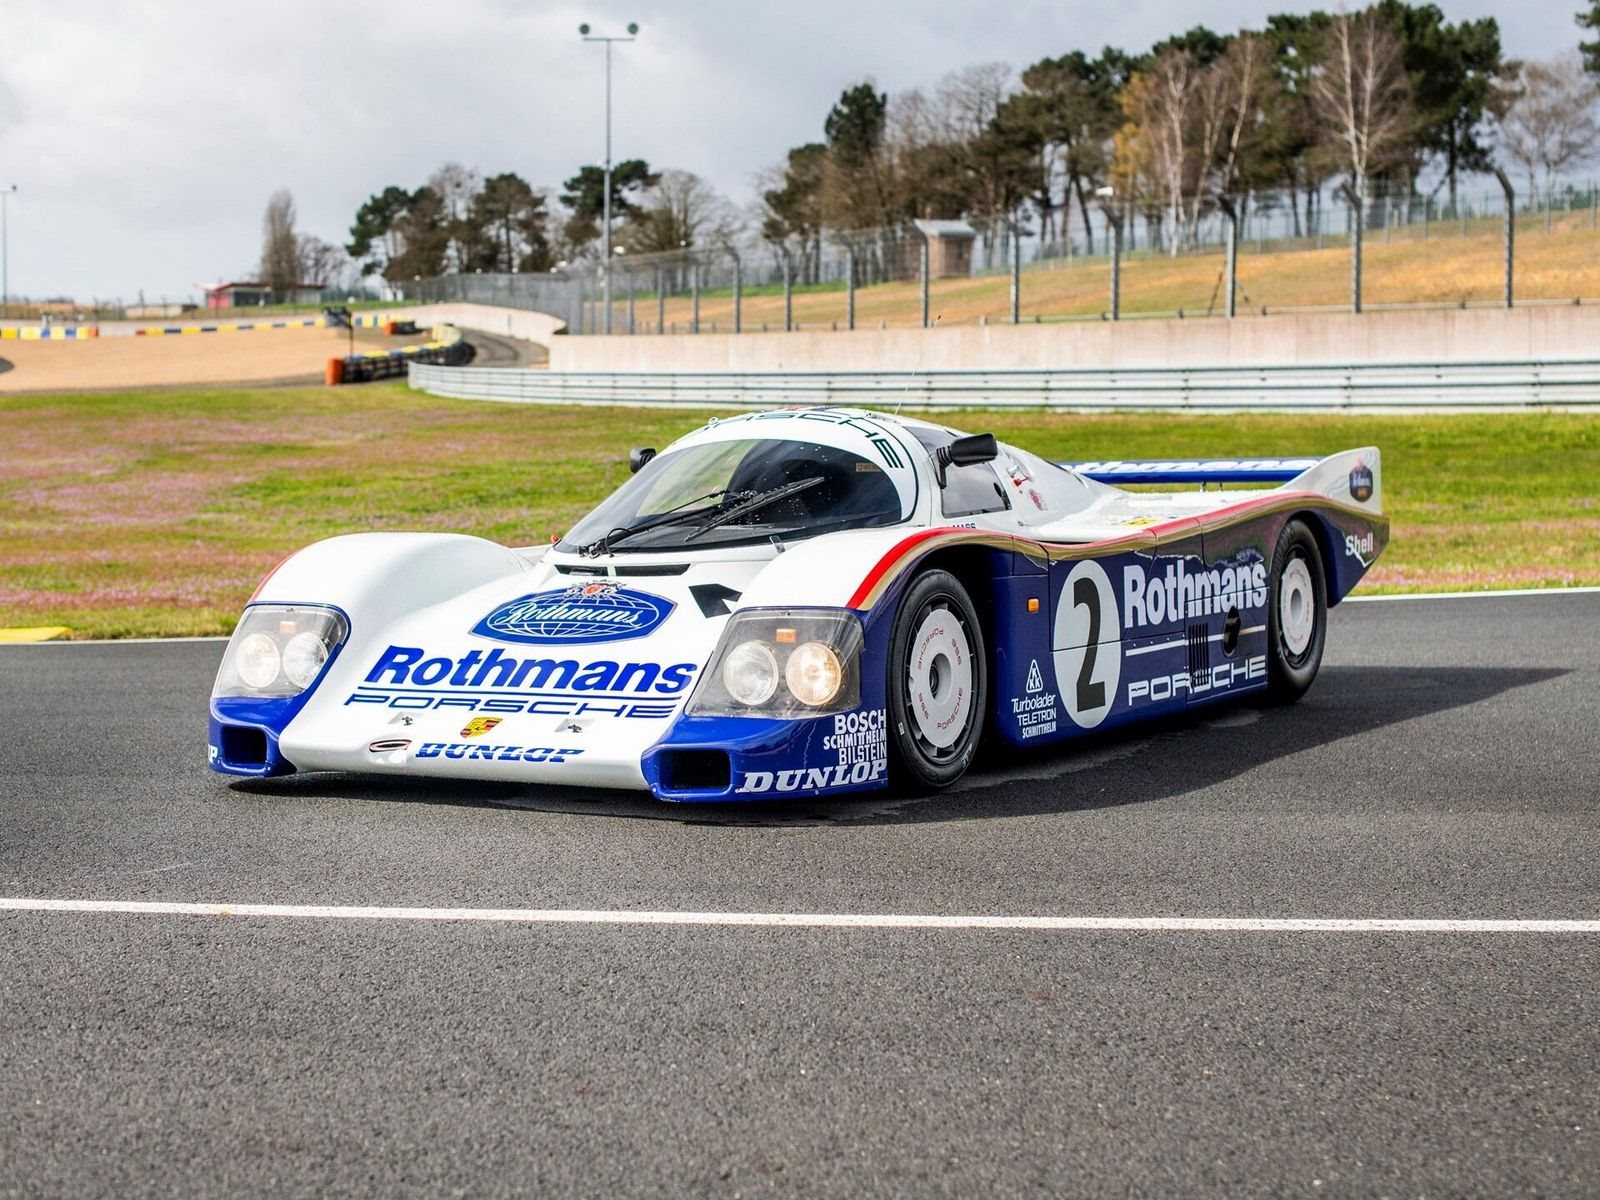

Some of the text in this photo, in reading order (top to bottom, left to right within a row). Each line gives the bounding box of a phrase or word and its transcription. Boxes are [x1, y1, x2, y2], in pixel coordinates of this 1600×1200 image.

[730, 411, 904, 469] SCHE
[1345, 532, 1373, 556] Shell
[1124, 560, 1267, 629] Rothmans
[495, 601, 644, 626] Rothmans
[1073, 577, 1106, 713] 2
[363, 645, 698, 693] Rothmans
[1128, 655, 1266, 706] PORSCHE
[344, 694, 677, 719] PORSCHE
[1011, 692, 1056, 713] Turbolader
[834, 709, 887, 735] BOSCH
[1017, 708, 1057, 726] TELETRON
[415, 743, 585, 762] DUNLOP
[839, 741, 887, 765] BILSTEIN
[735, 758, 888, 793] DUNLOP
